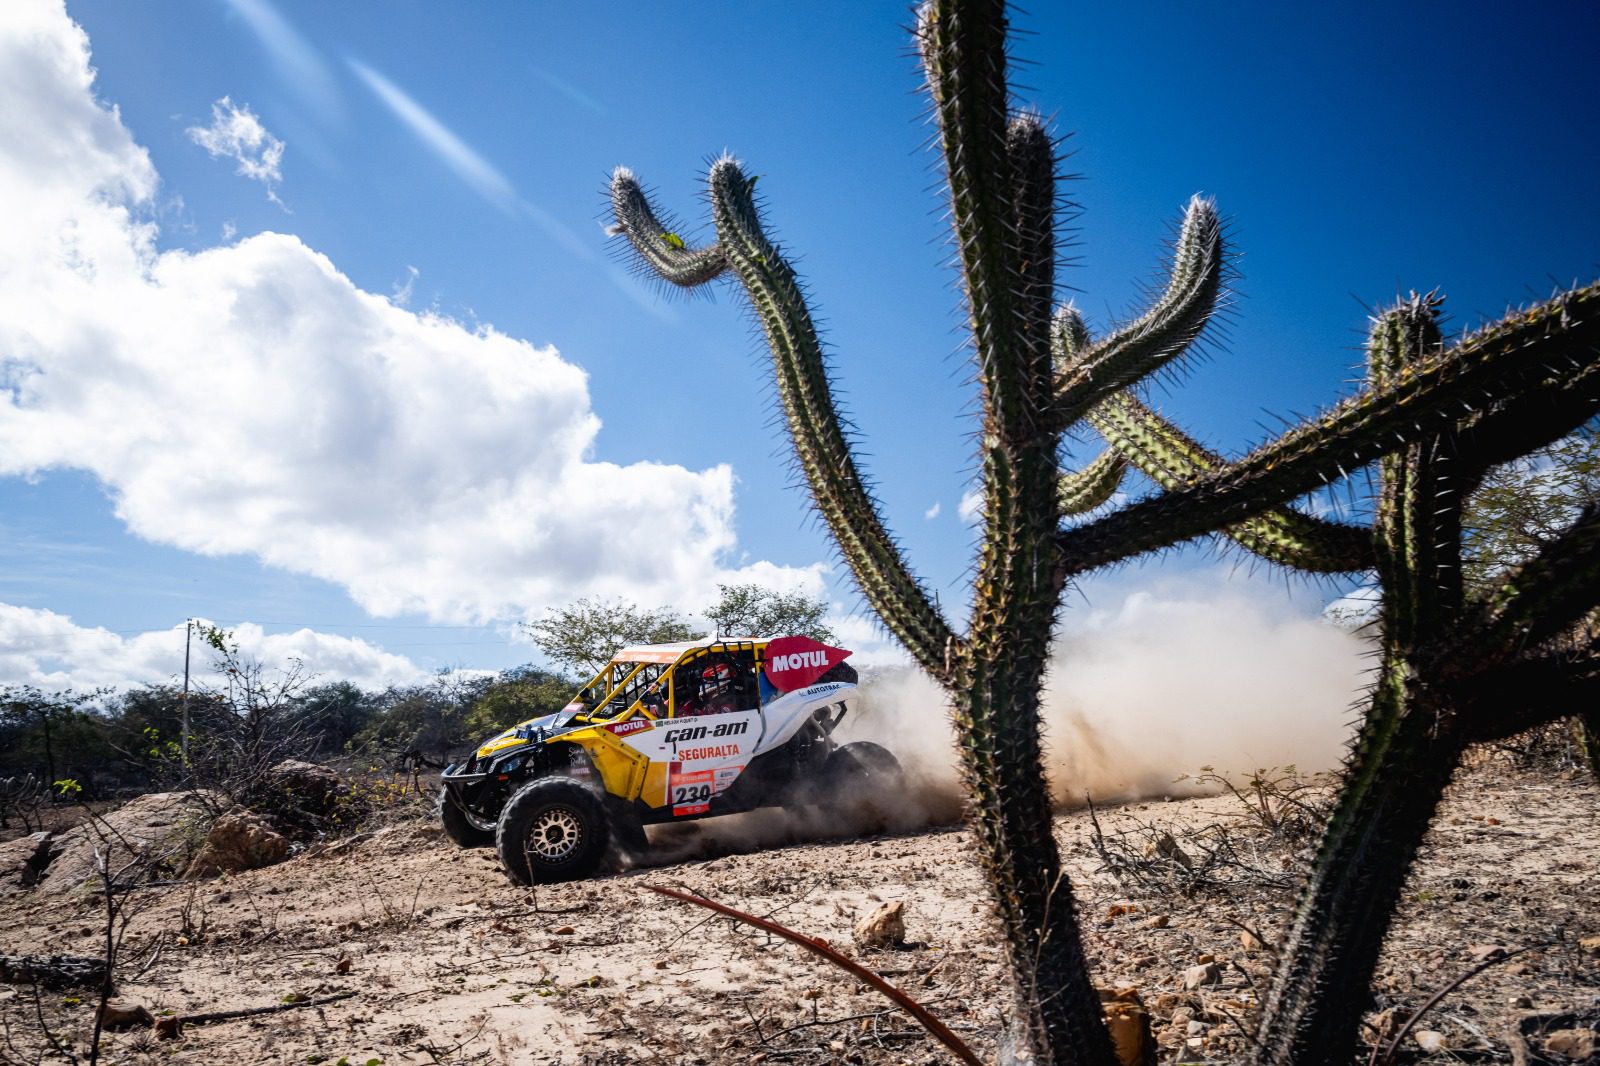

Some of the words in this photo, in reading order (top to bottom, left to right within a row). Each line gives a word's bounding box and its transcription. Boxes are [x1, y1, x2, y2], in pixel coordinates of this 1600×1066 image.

[772, 650, 829, 673] MOTUL
[614, 720, 645, 734] MOTUL
[664, 722, 748, 743] can-am
[678, 744, 740, 762] SEGURALTA
[675, 784, 711, 804] 230
